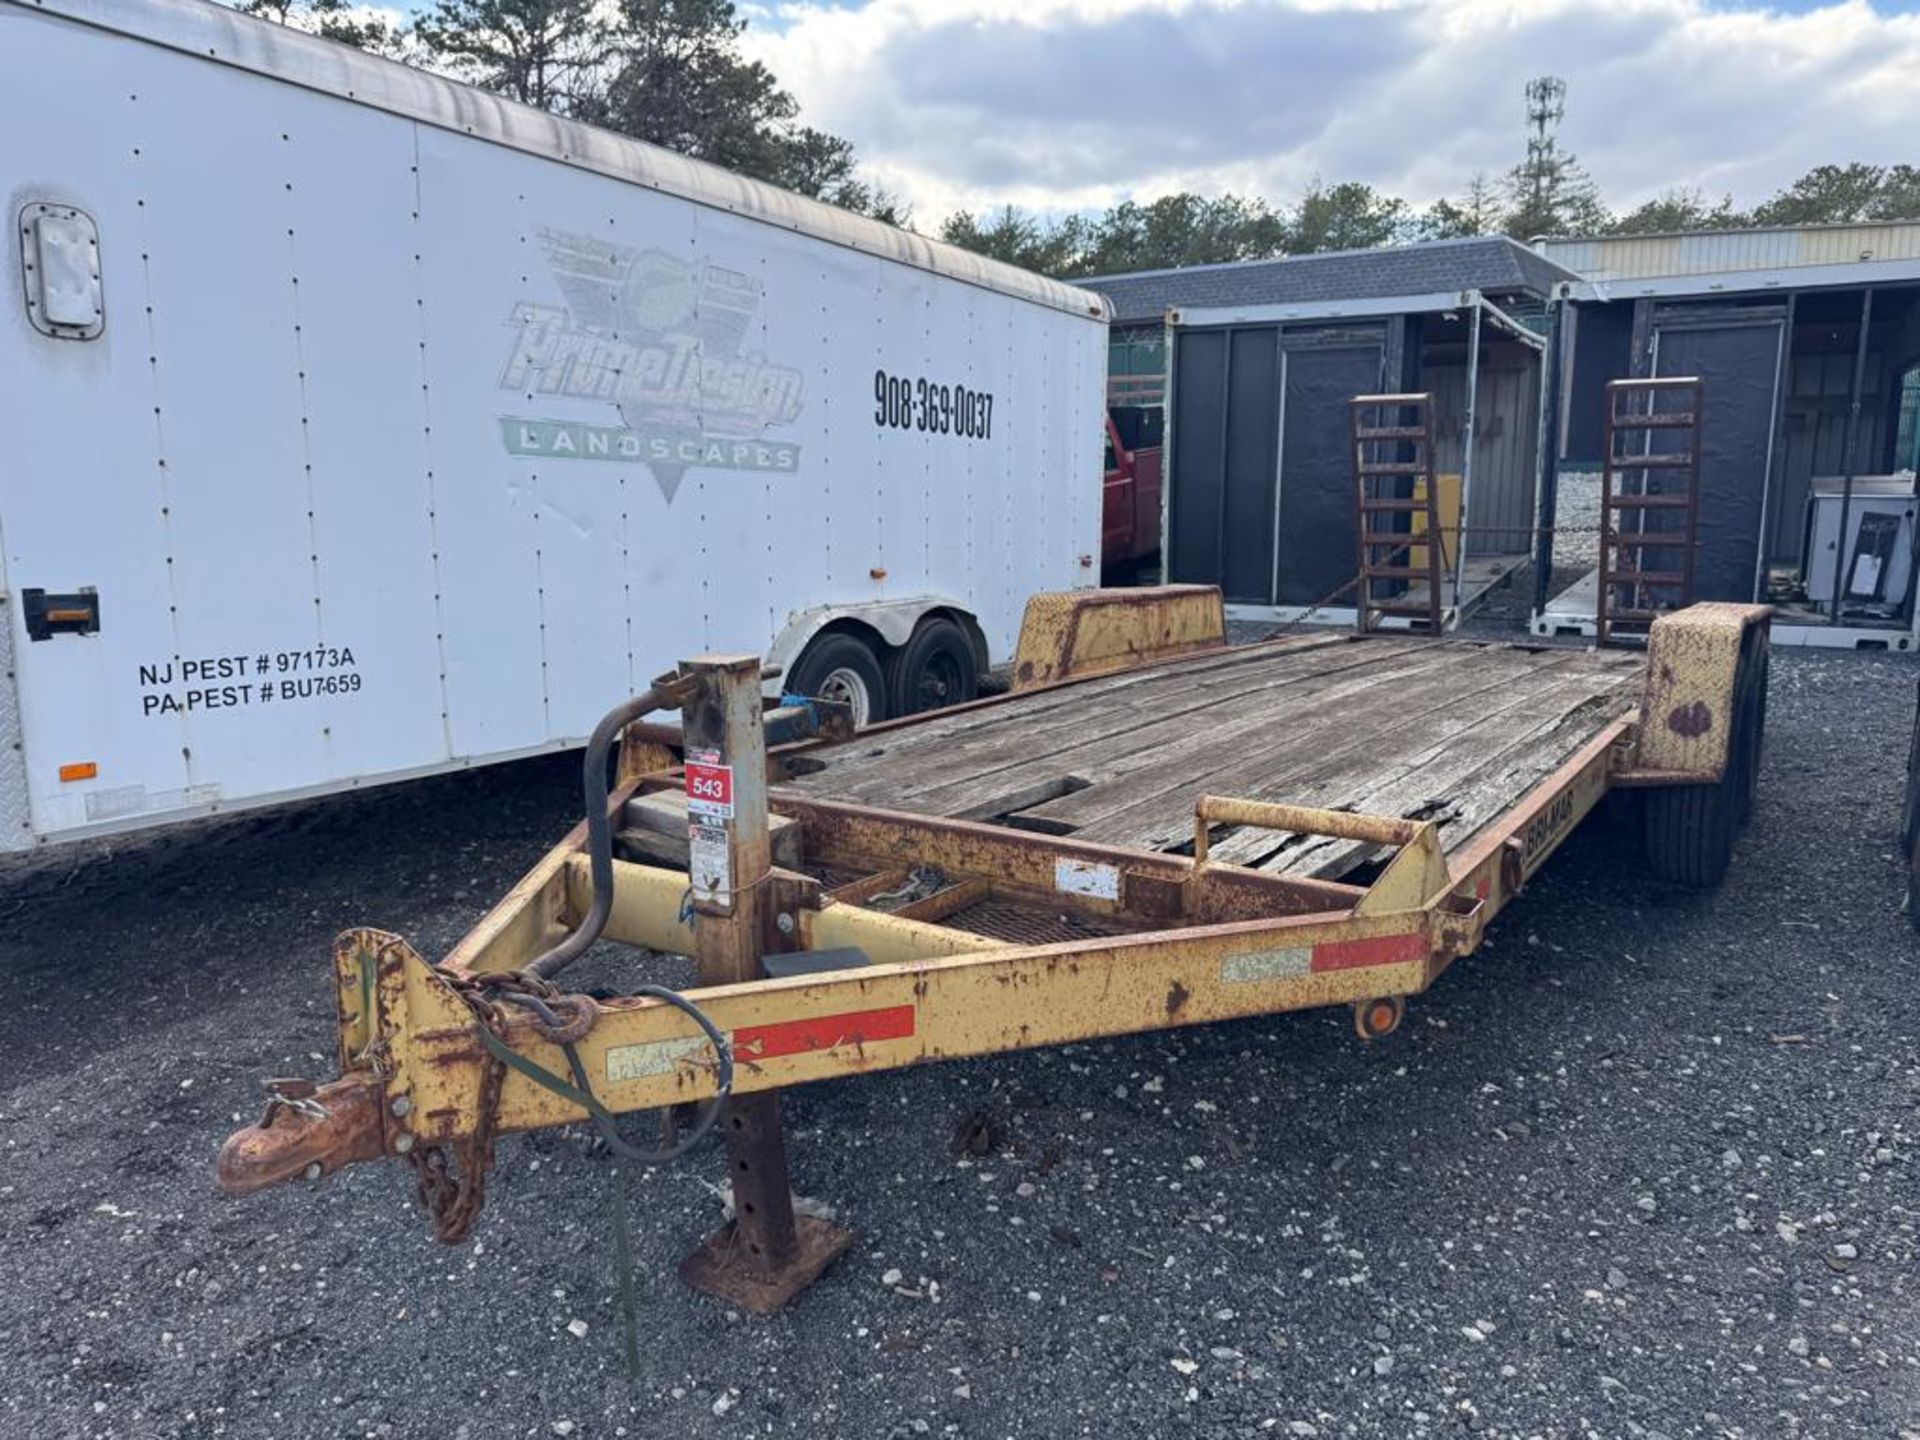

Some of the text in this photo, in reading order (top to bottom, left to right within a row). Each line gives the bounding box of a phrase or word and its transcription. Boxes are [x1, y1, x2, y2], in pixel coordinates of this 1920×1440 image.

[520, 426, 795, 469] LANDSCAPES
[139, 647, 356, 686] NJ PEST # 97173A
[143, 673, 362, 717] PA PEST # BU7659
[692, 777, 724, 799] 543
